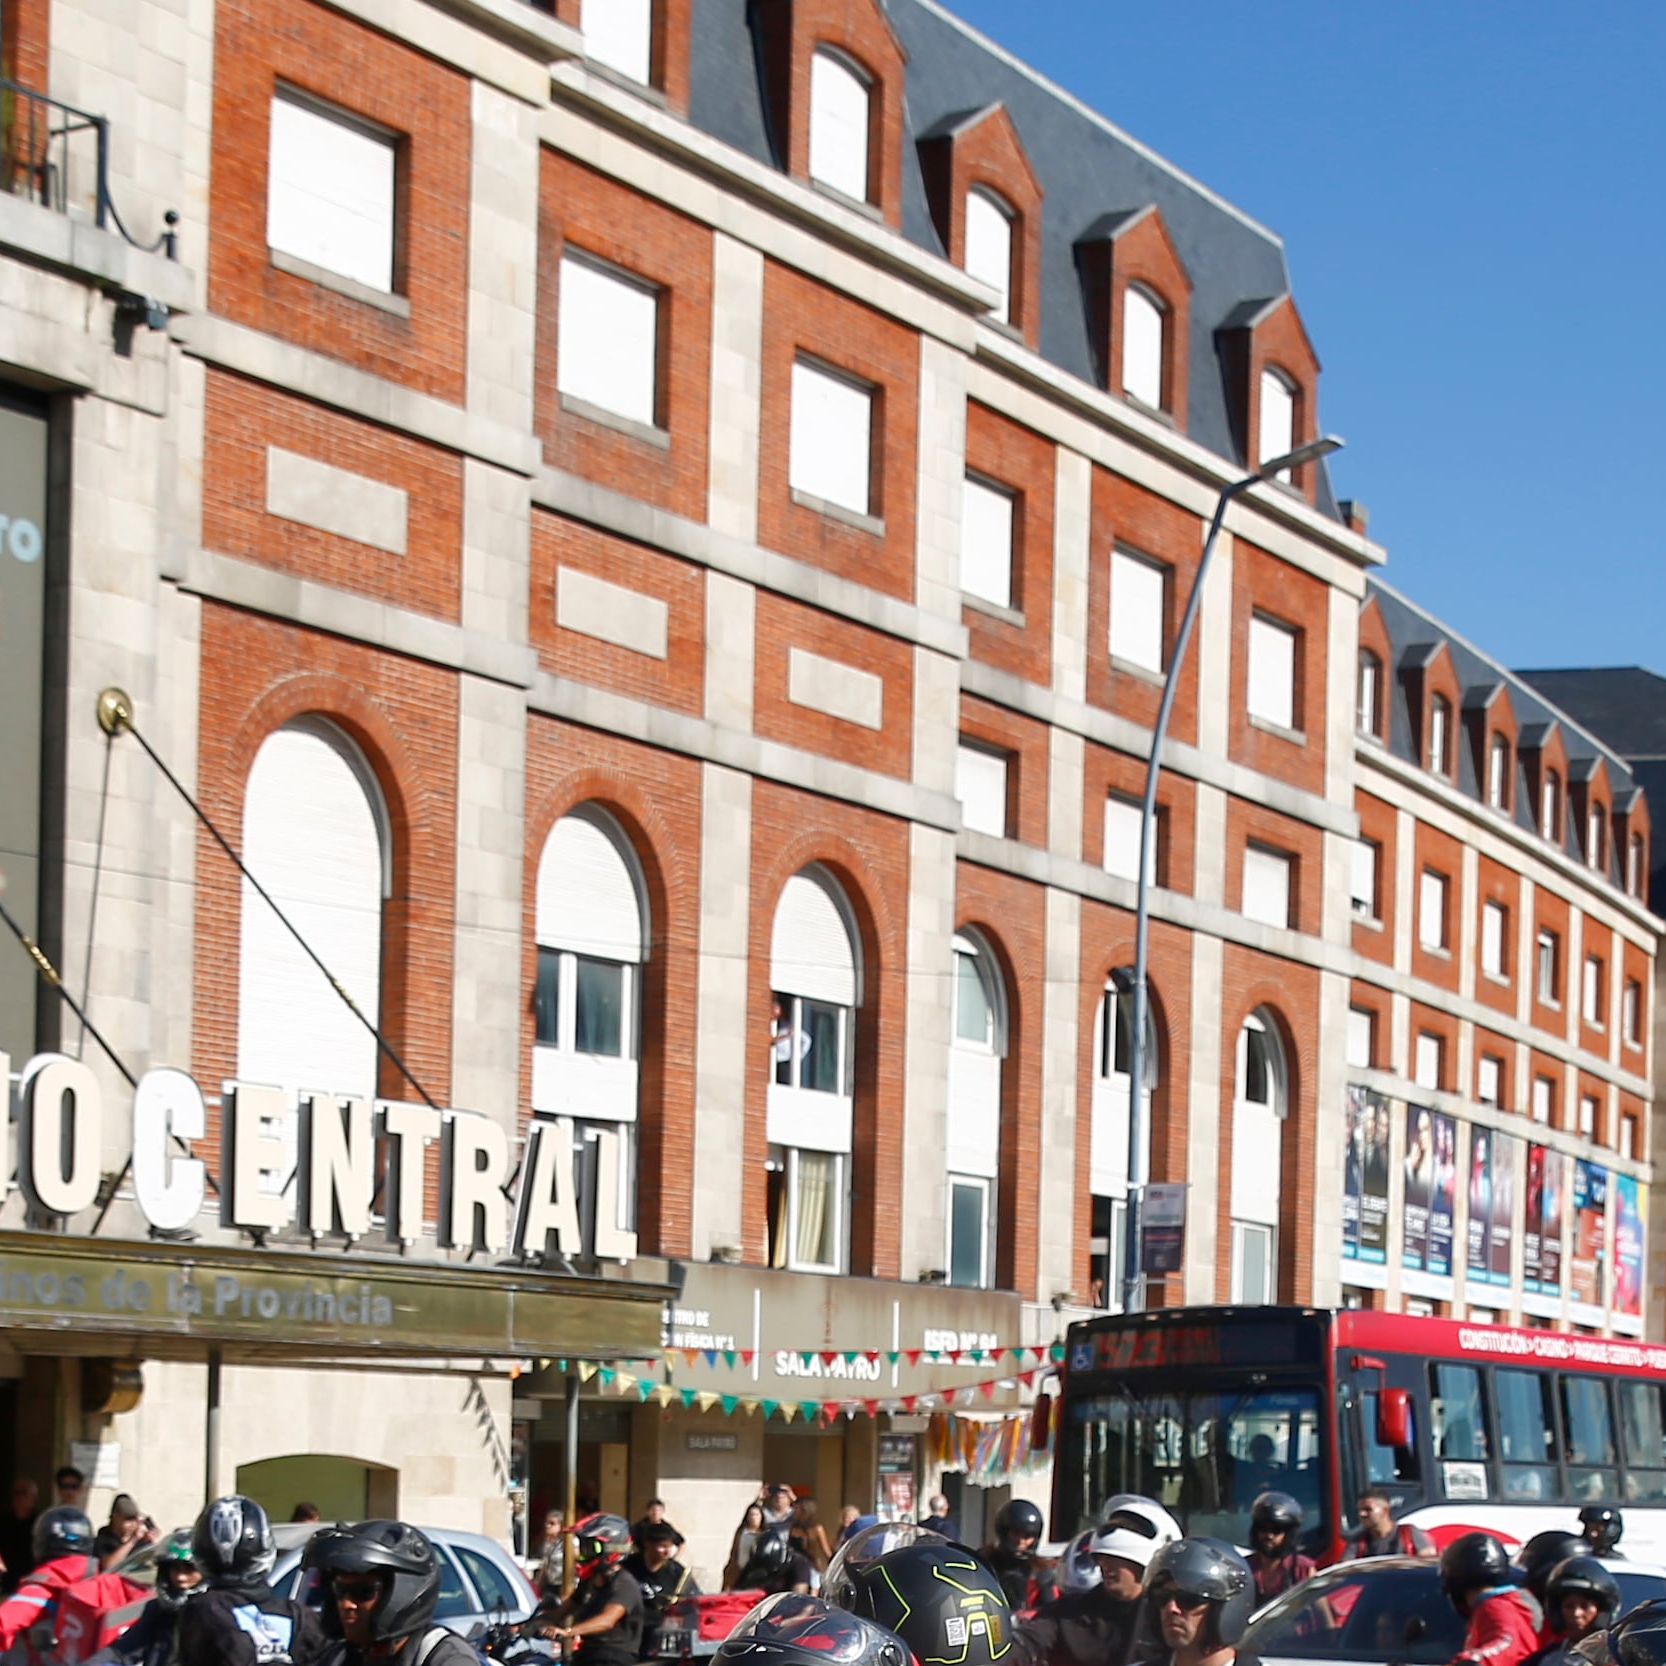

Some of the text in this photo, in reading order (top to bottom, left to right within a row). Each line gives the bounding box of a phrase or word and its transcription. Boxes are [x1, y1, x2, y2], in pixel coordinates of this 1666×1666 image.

[133, 1067, 638, 1265] CENTRAL
[102, 1268, 152, 1312] de
[167, 1273, 201, 1316] la
[214, 1275, 393, 1325] Provincia
[775, 1350, 821, 1378] SALA
